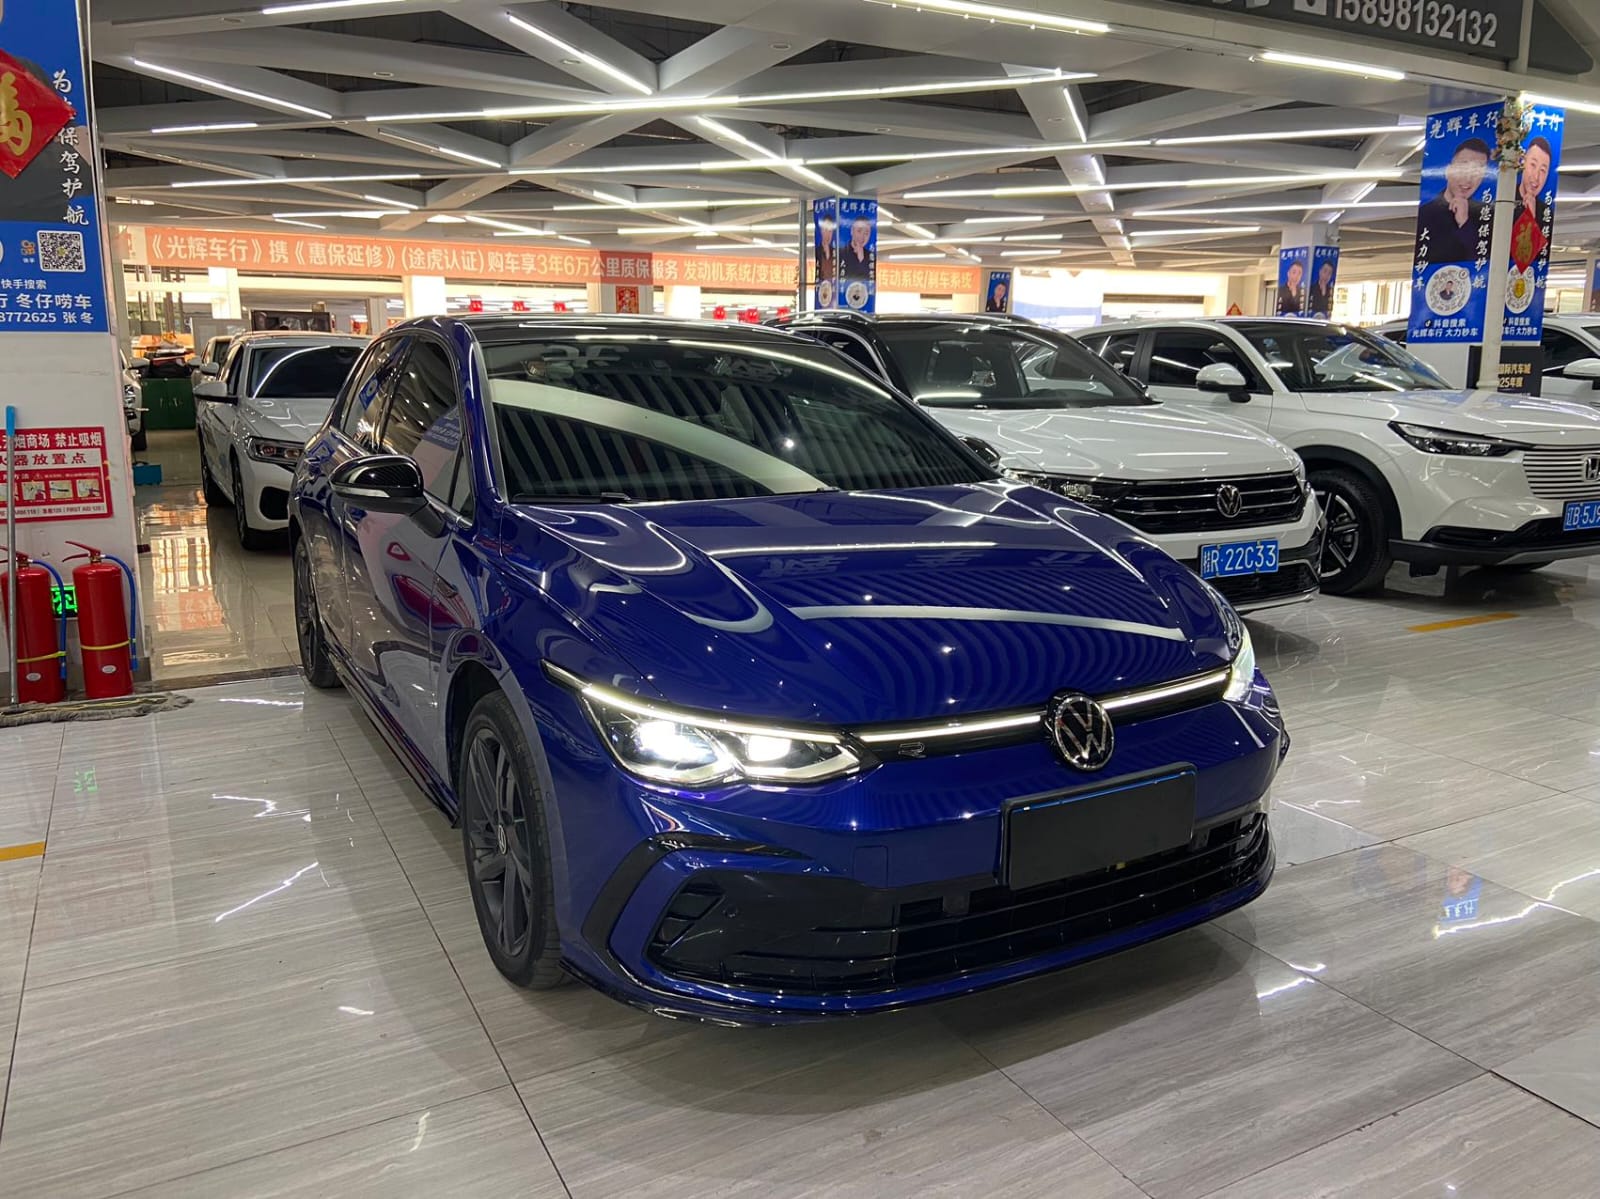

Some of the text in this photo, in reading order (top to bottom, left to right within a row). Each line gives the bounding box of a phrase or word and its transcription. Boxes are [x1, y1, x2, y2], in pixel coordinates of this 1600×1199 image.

[53, 69, 89, 225] 为保驾护航
[1, 279, 47, 289] 快手搜索
[63, 312, 94, 323] 张冬
[55, 431, 102, 448] 禁止吸烟
